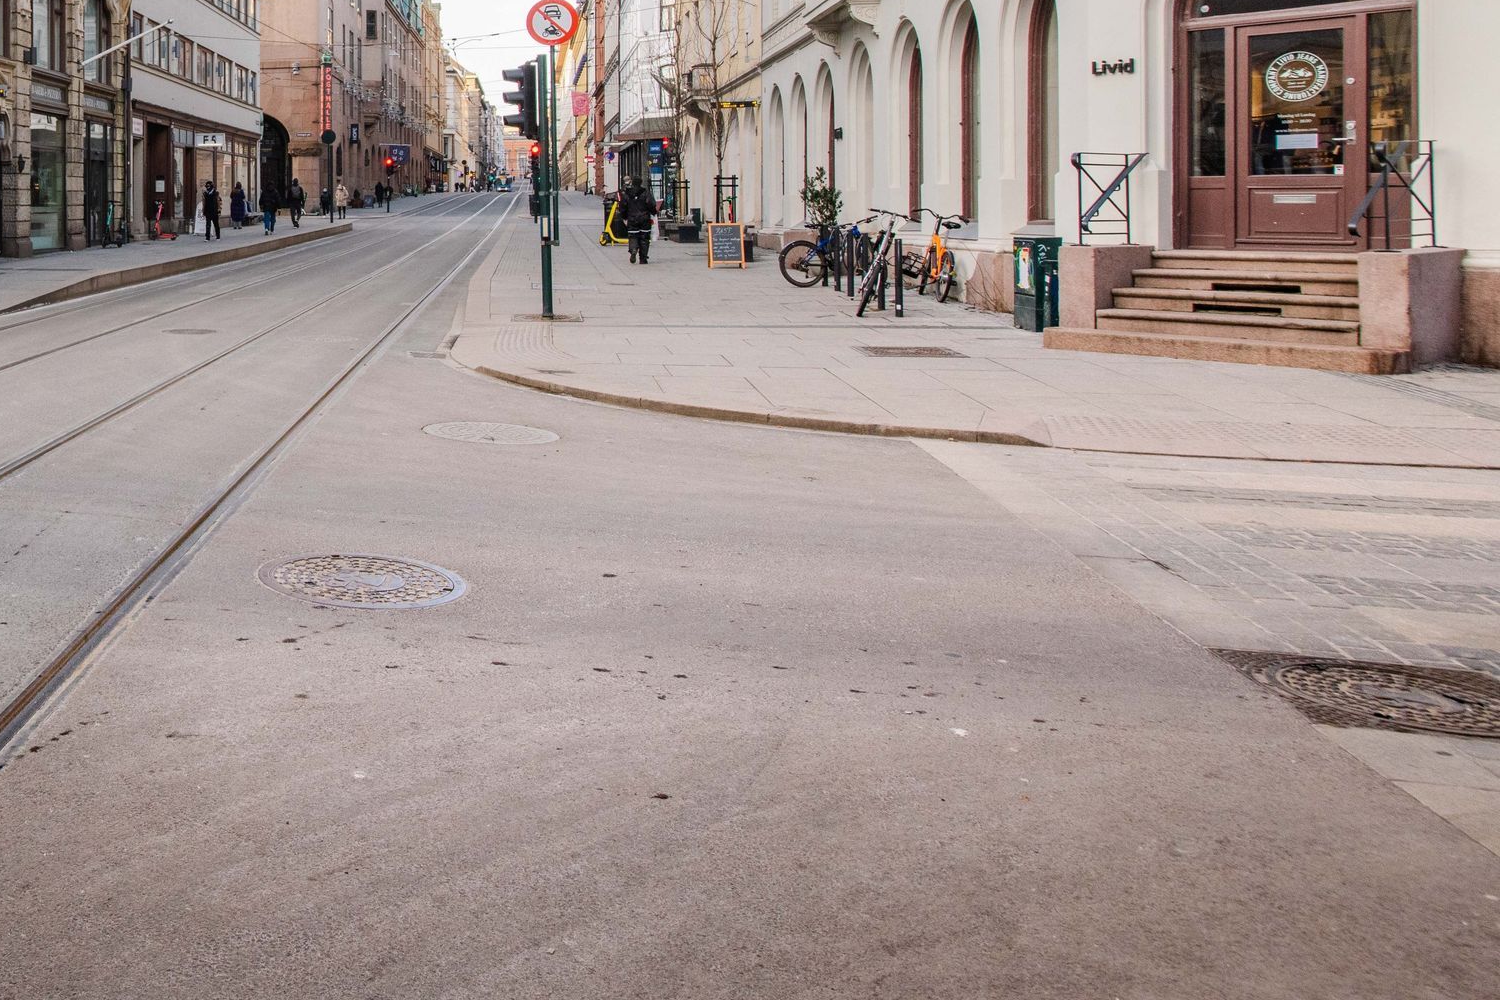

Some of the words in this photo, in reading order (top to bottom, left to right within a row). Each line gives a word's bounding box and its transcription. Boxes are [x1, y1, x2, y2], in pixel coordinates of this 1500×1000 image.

[1092, 58, 1134, 75] Livid
[1276, 54, 1295, 66] LIVID
[1296, 53, 1319, 65] JEANS
[1267, 67, 1283, 95] COMPANY
[1283, 64, 1327, 100] MANUFACTURING
